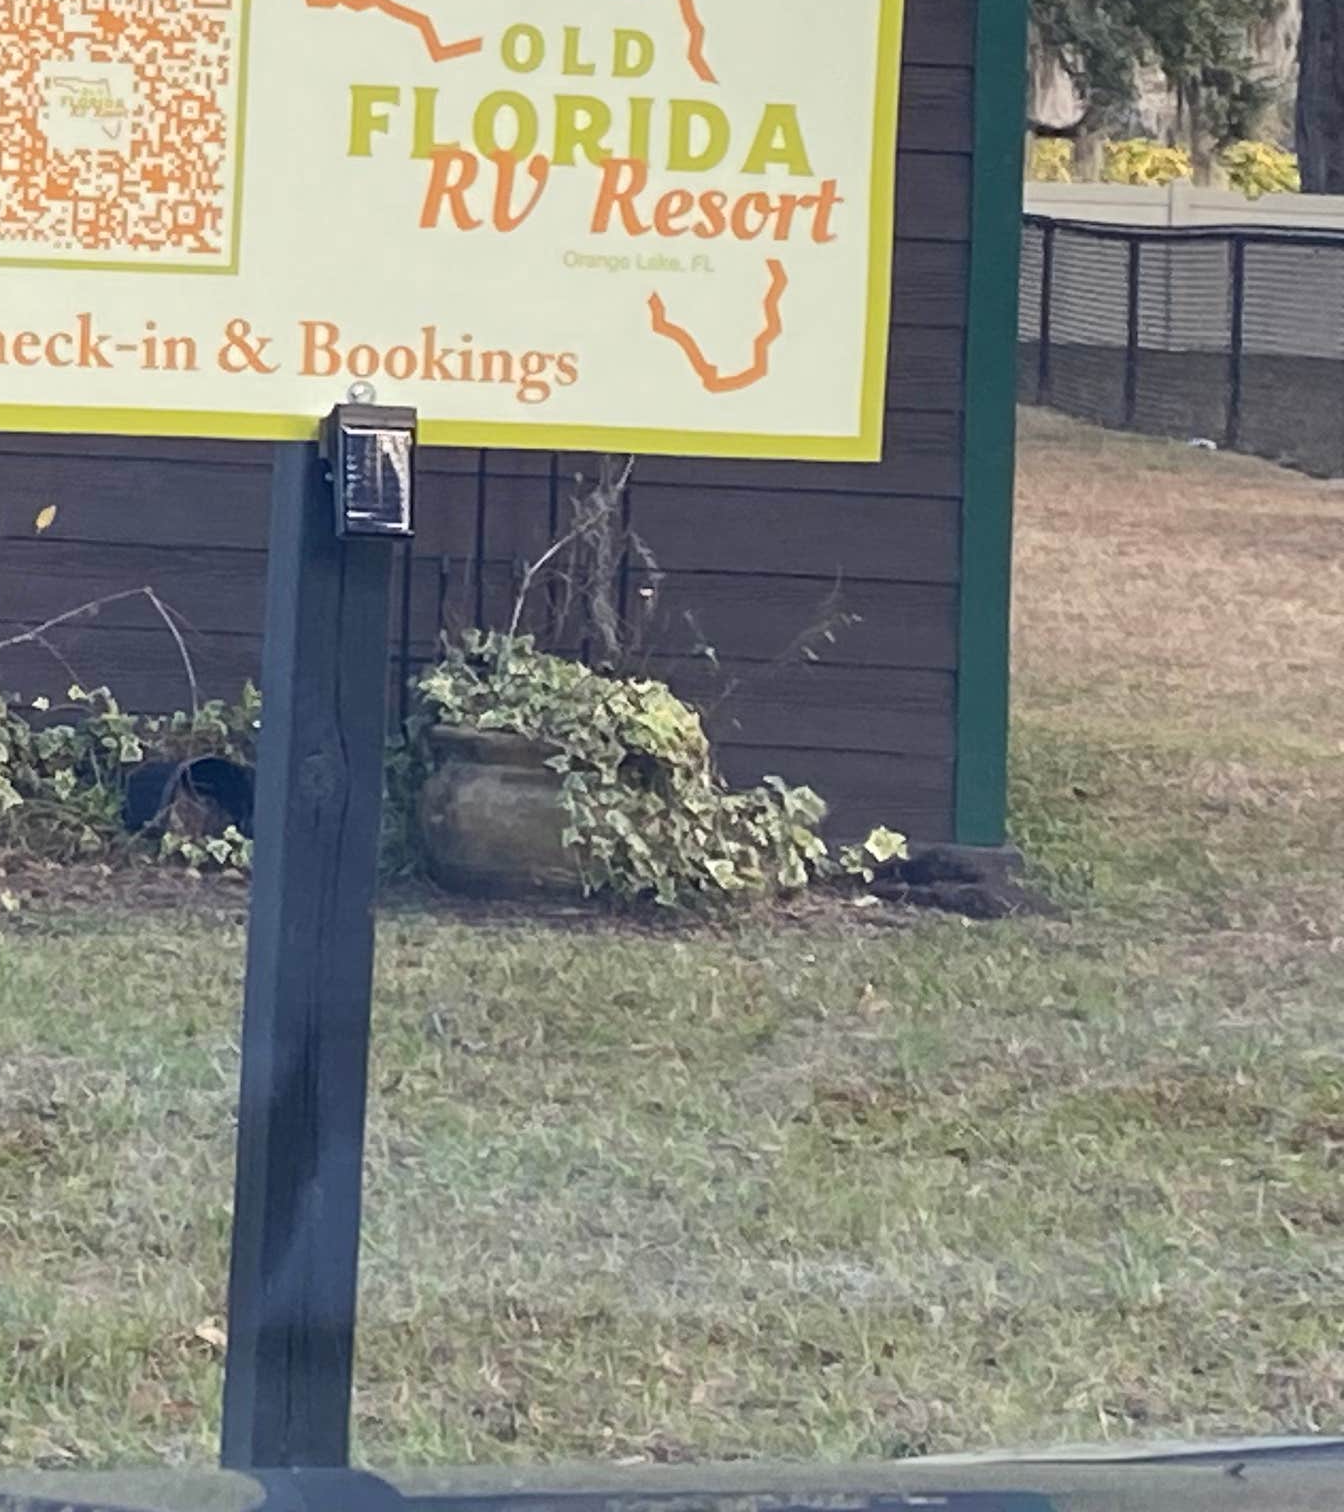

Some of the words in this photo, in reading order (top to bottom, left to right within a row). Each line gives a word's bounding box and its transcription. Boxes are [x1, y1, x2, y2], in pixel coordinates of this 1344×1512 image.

[500, 23, 654, 78] OLD
[348, 85, 814, 176] FLORIDA
[418, 147, 549, 232] RV
[590, 158, 845, 244] Resort
[562, 250, 631, 273] Orange
[690, 255, 715, 273] FL
[216, 319, 280, 375] &
[297, 321, 578, 404] Bookings
